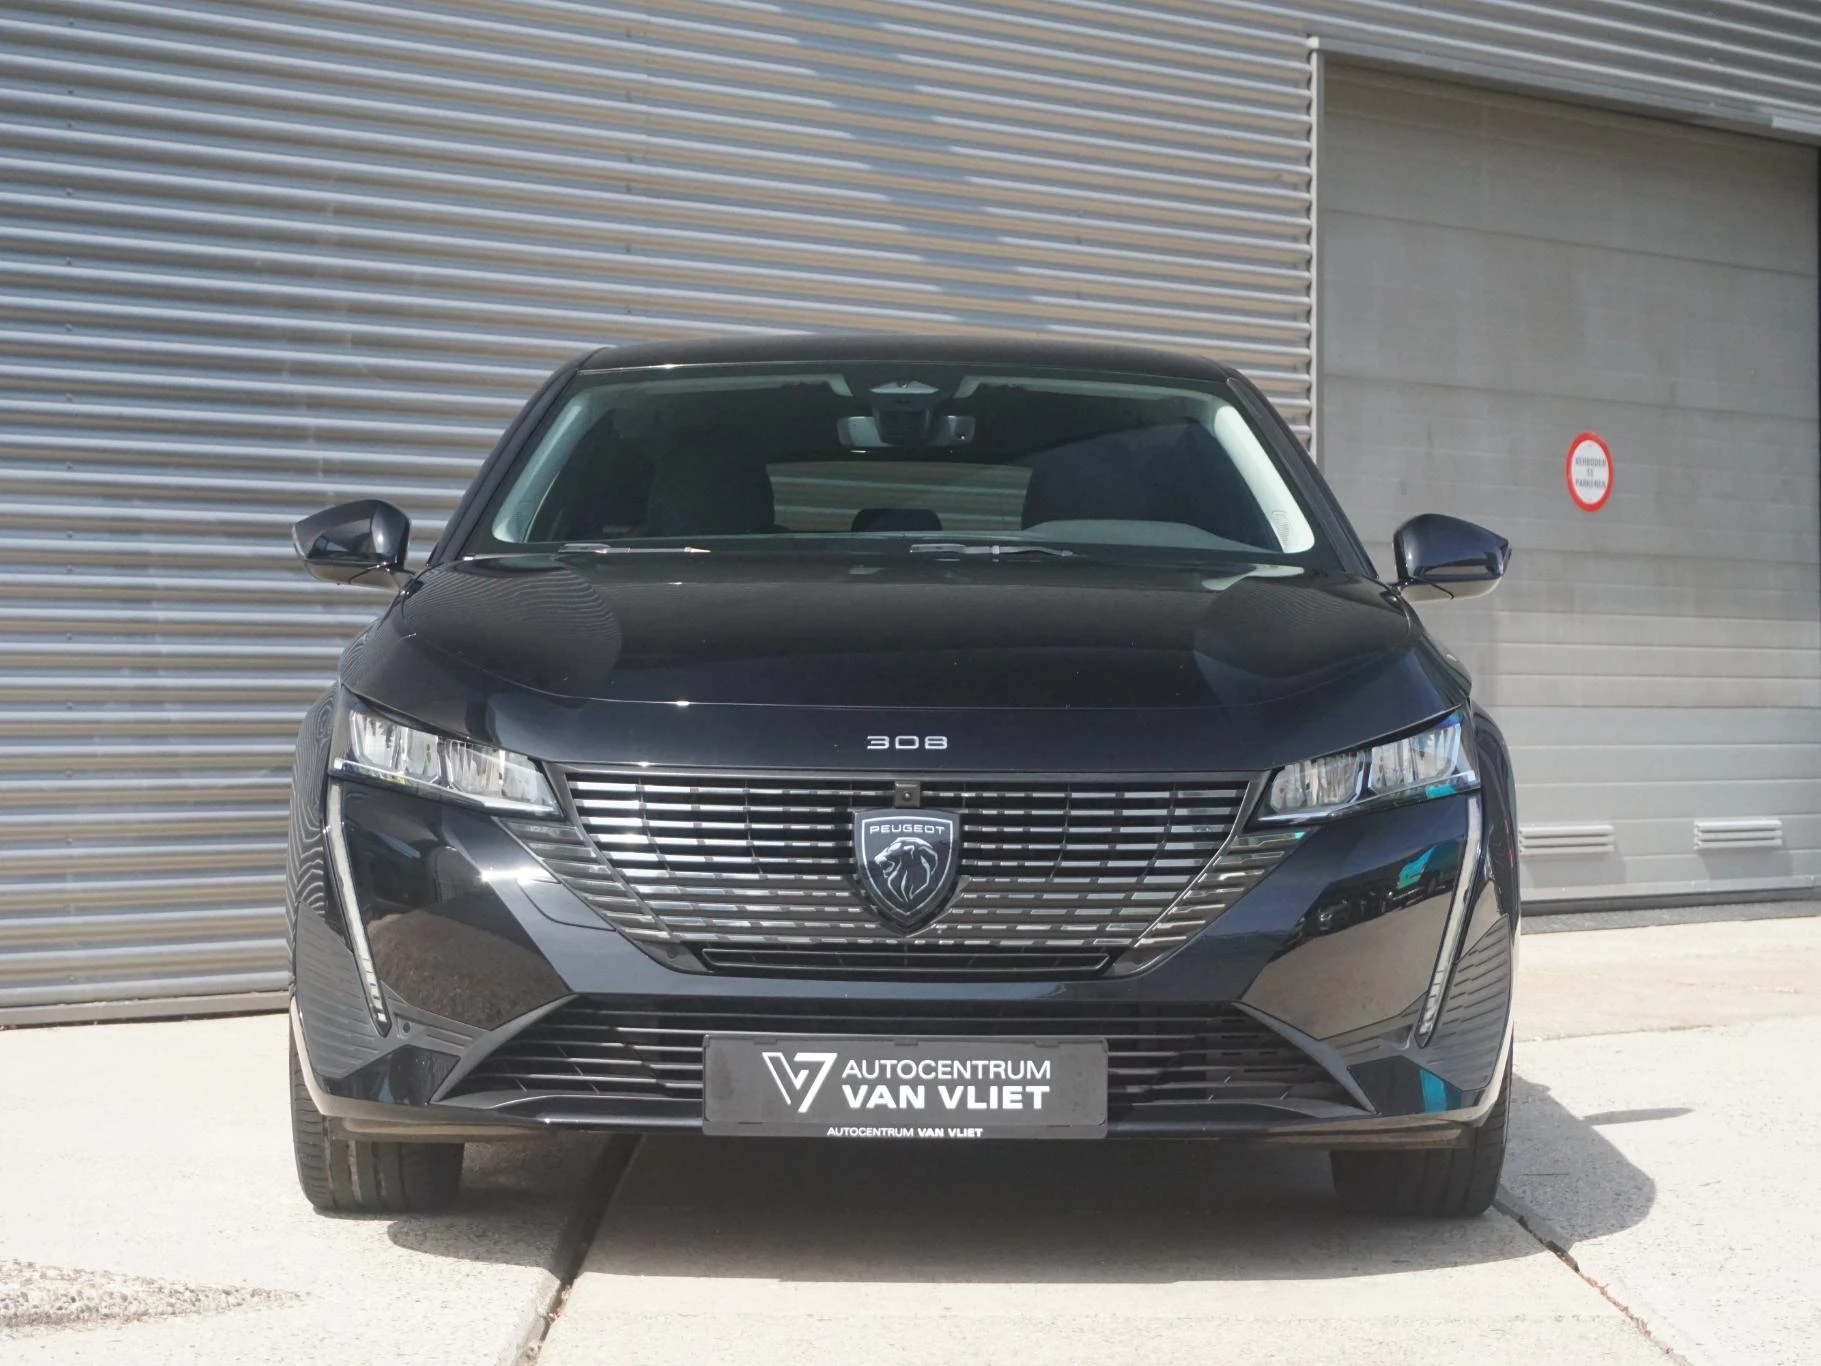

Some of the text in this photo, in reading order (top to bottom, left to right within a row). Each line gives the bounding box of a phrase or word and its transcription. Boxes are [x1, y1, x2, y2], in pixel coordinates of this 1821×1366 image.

[867, 736, 948, 749] 308
[869, 824, 945, 835] PEUGEOT
[841, 1059, 1051, 1080] AUTOCENTRUM
[841, 1085, 1051, 1110] VAN VLIET
[826, 1126, 984, 1138] AUTOCENTRUM VAN VLIET
